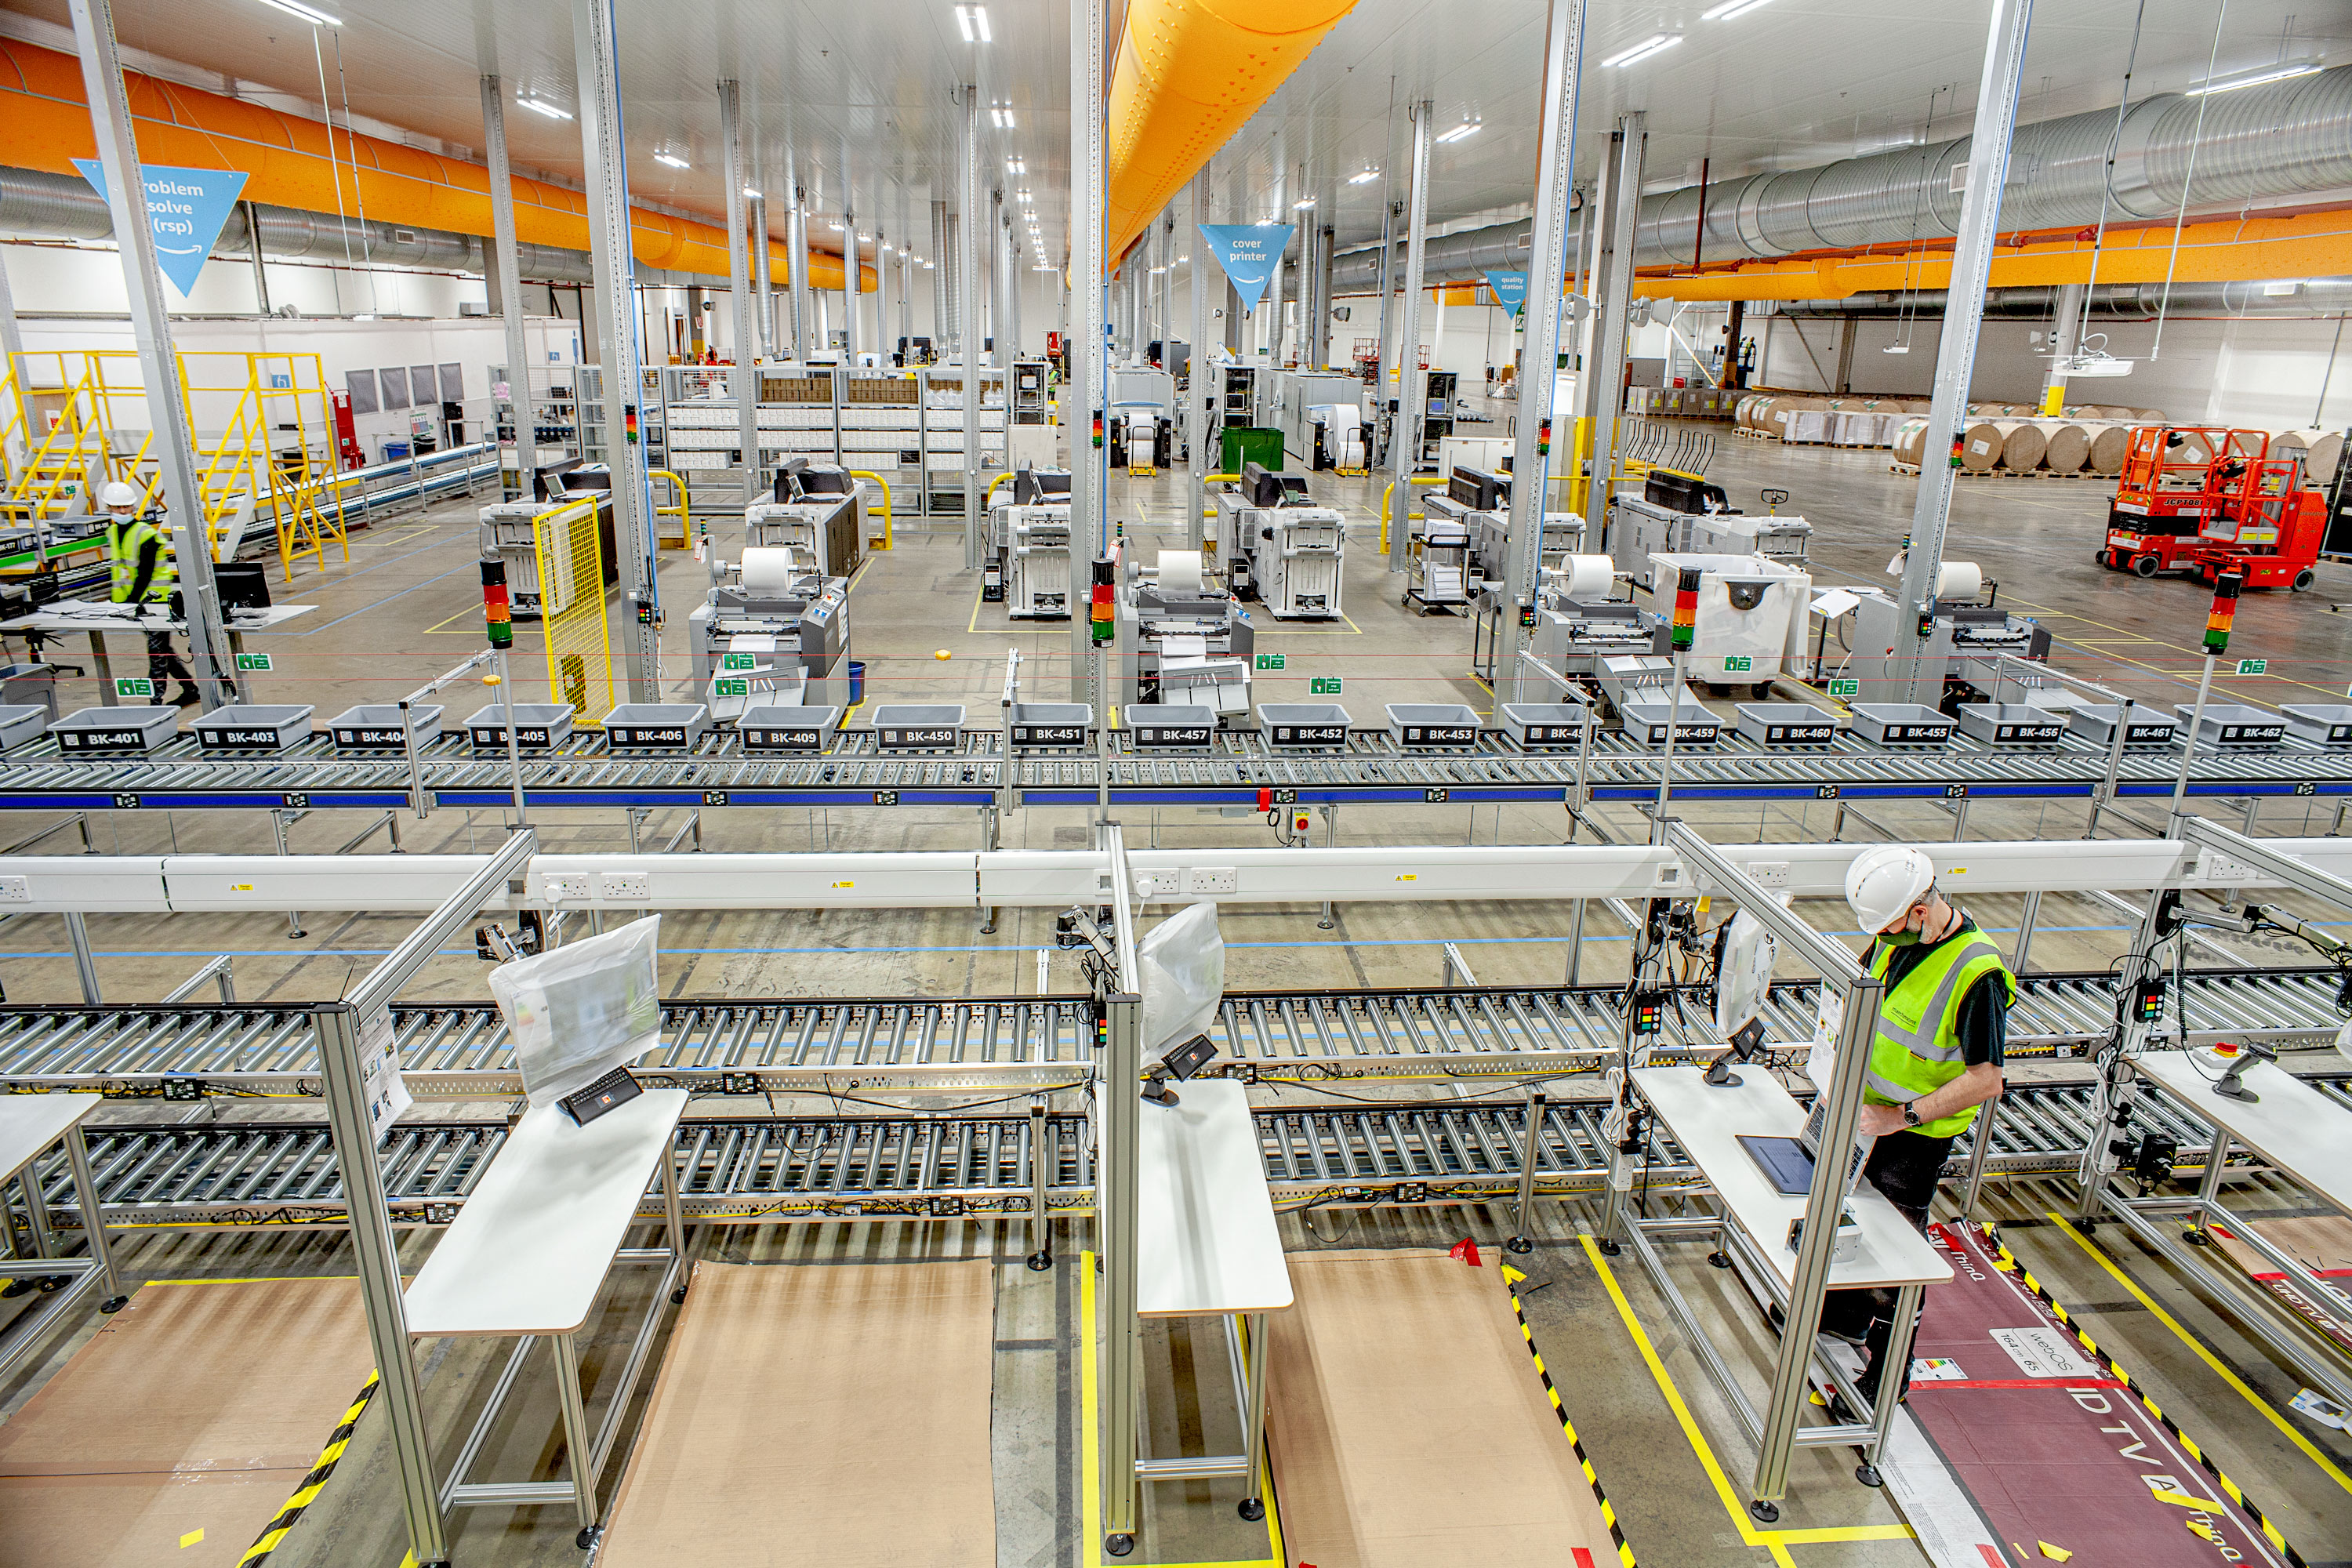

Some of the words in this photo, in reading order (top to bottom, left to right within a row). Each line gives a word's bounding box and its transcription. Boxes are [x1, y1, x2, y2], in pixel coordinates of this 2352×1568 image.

[147, 200, 193, 215] solve
[154, 217, 193, 235] (rsp)
[1229, 251, 1267, 263] printer
[227, 731, 275, 742] BK-403
[499, 731, 546, 742] B-405
[636, 731, 683, 742] BK-406
[771, 732, 817, 743] BK-409
[906, 731, 953, 742] BK-450
[1036, 729, 1080, 739] BK-451
[1163, 730, 1207, 741] BK-457
[1299, 729, 1343, 739] BK-452
[1429, 729, 1472, 740] BK-453
[1551, 728, 1582, 739] BK-45
[1674, 728, 1715, 738] BK-459
[1791, 728, 1831, 738] BK-460
[1907, 728, 1947, 738] BK-455
[2019, 728, 2059, 738] BK-456
[2132, 728, 2171, 738] BK-461
[2243, 728, 2281, 738] BK-462
[88, 733, 140, 745] BK-401
[2272, 1284, 2303, 1304] UHD
[2300, 1305, 2325, 1319] TV
[2030, 1333, 2073, 1370] webOS
[2024, 1359, 2040, 1371] 65
[2100, 1419, 2164, 1466] TV
